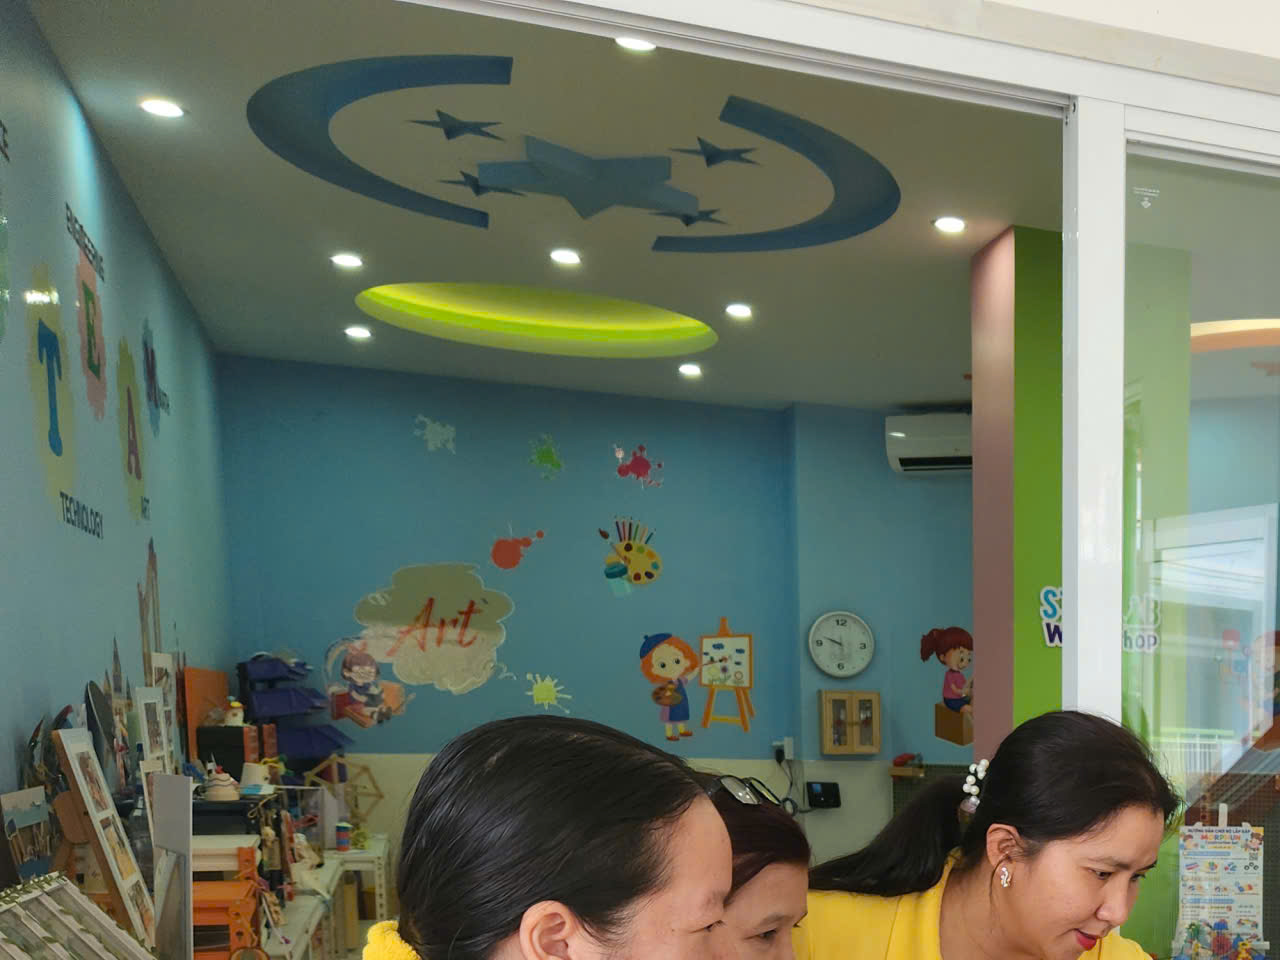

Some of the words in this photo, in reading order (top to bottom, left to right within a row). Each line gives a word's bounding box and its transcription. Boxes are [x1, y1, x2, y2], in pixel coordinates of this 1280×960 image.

[60, 491, 104, 540] TECHNOLOGY
[385, 597, 484, 657] Art
[835, 619, 847, 627] 12
